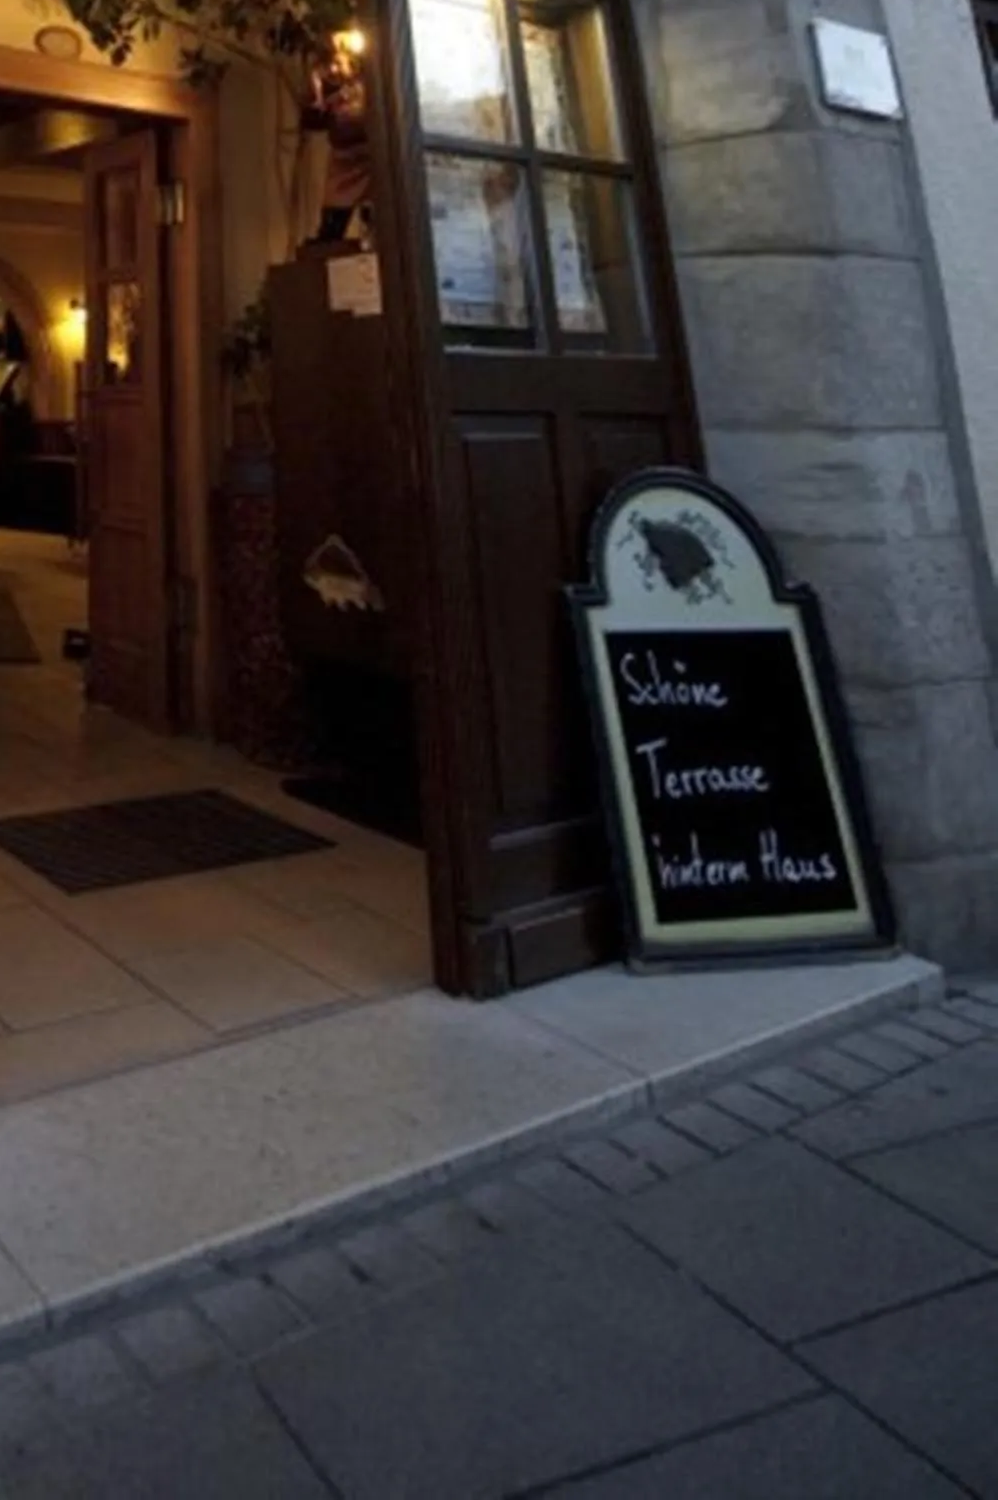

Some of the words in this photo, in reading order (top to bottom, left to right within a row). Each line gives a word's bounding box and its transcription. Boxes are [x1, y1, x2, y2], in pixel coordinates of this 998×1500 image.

[619, 649, 729, 708] Schöne
[635, 736, 770, 799] Terrasse
[651, 829, 750, 890] hinterm
[759, 826, 838, 882] Haus
